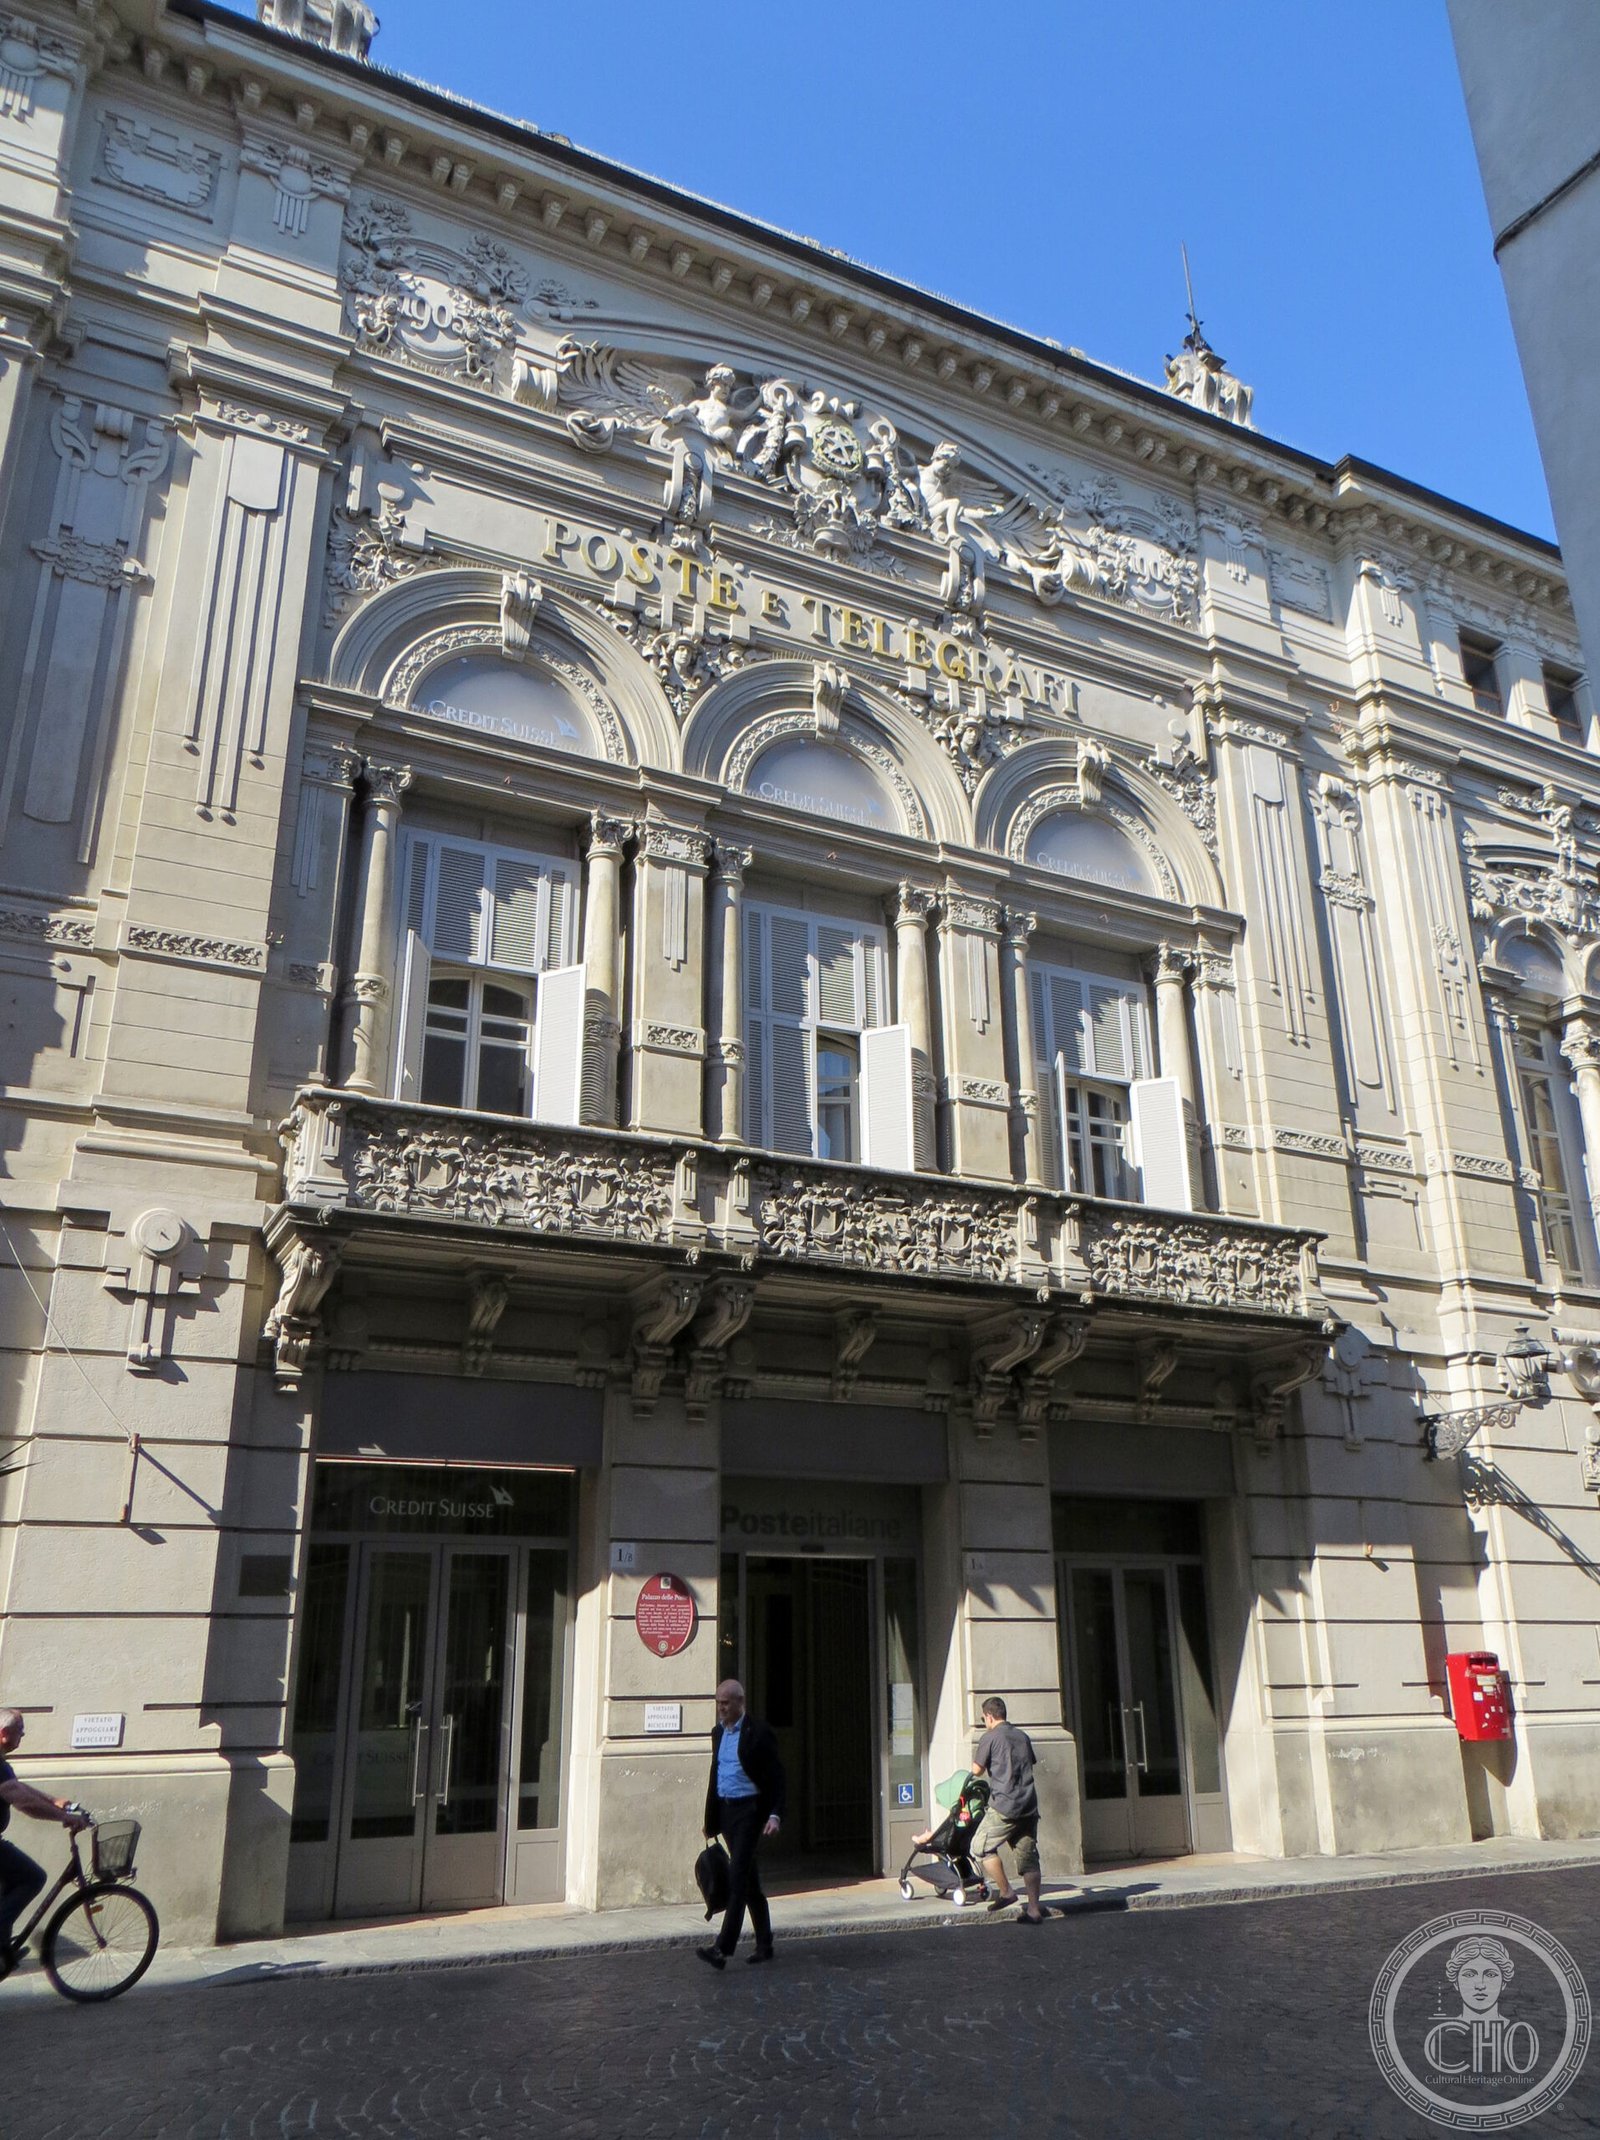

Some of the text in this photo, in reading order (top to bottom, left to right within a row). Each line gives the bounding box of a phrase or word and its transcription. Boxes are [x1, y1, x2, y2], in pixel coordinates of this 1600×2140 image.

[399, 294, 468, 334] 1905
[542, 516, 1080, 715] POSTE E TELEGRAFI
[429, 700, 500, 730] CREDIT
[369, 1496, 494, 1519] CREDIT SUISSE
